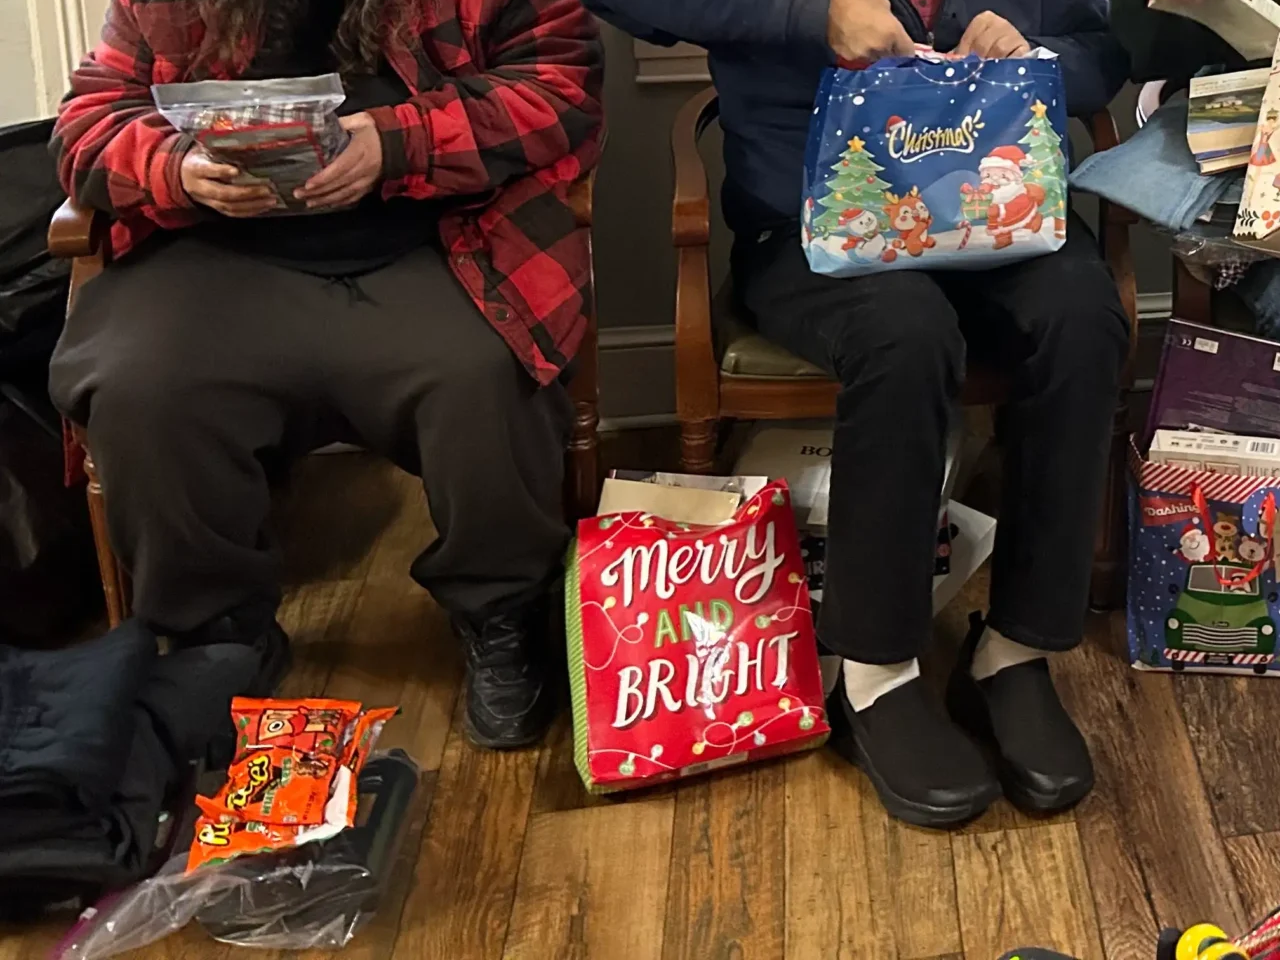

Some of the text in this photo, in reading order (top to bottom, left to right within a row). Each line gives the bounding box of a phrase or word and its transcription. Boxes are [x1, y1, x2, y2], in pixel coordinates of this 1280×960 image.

[888, 115, 975, 163] Christmas
[1144, 502, 1200, 517] Dashing
[600, 521, 785, 607] Merry
[654, 599, 734, 648] AND
[611, 631, 798, 728] BRIGHT
